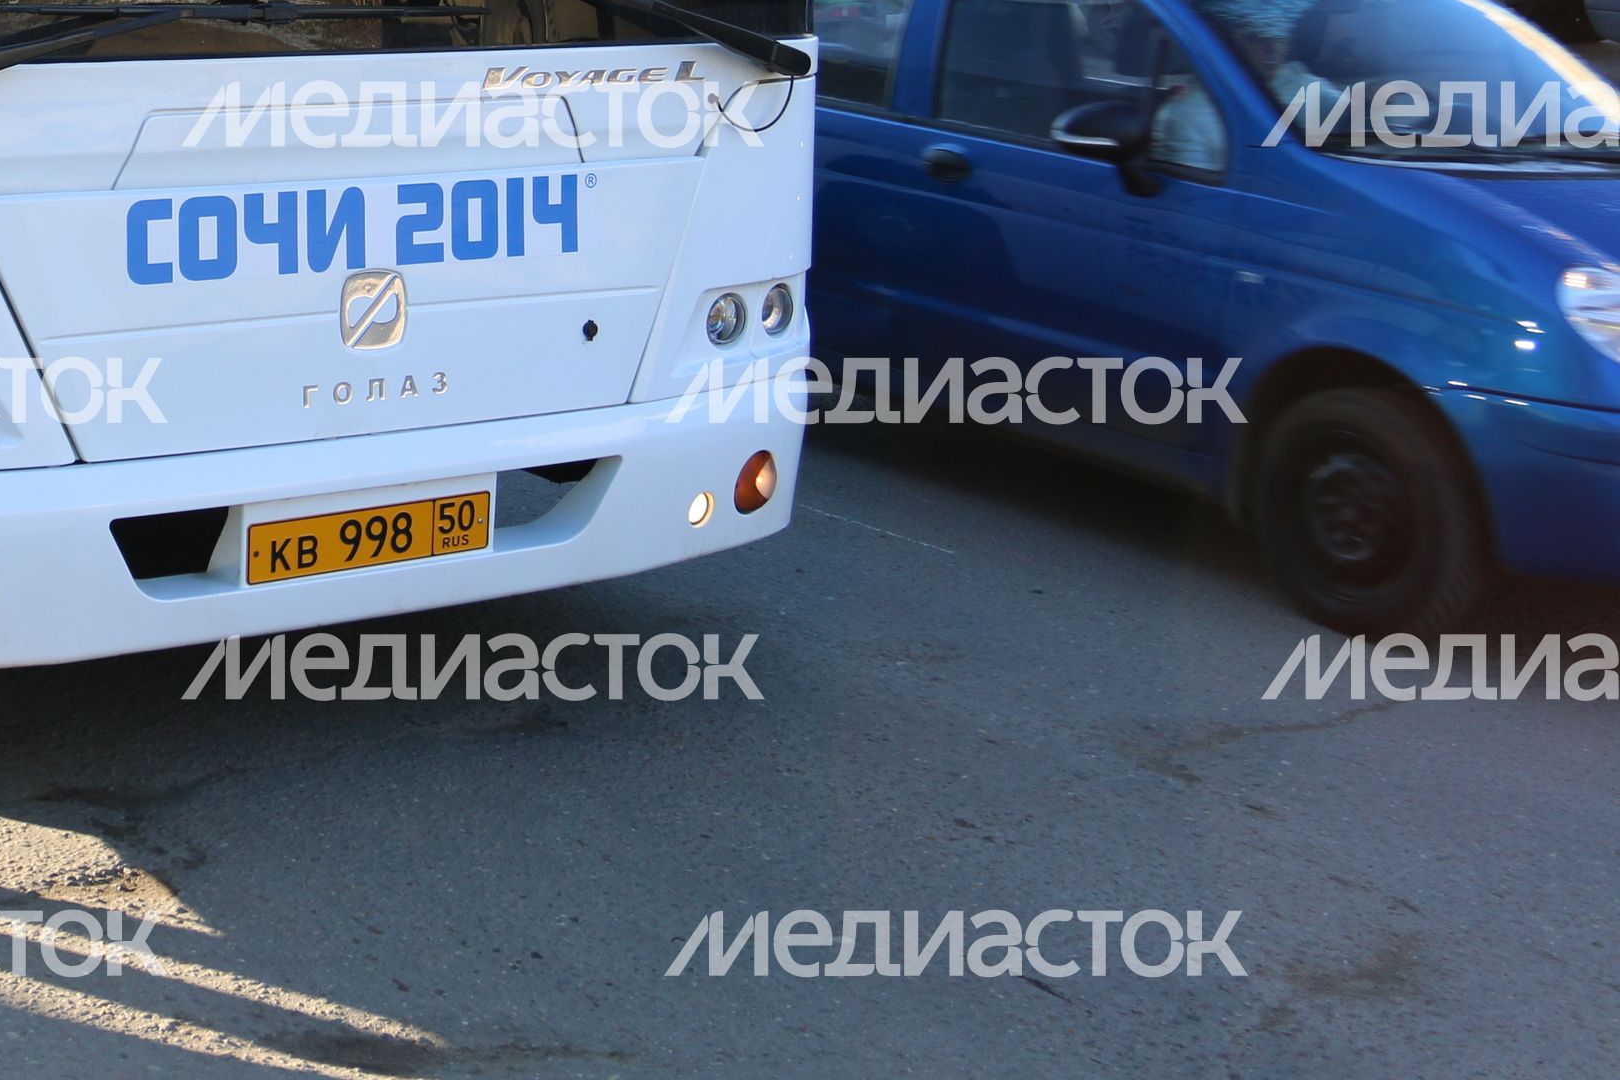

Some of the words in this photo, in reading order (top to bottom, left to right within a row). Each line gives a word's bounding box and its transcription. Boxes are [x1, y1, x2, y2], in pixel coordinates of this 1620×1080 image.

[674, 60, 706, 83] L
[126, 186, 366, 286] СОЧИ
[395, 174, 578, 266] 2014
[302, 371, 448, 409] ГОЛАЗ
[270, 535, 318, 574] КВ
[339, 511, 413, 562] 998
[438, 499, 475, 534] 50
[442, 534, 470, 548] RUS
